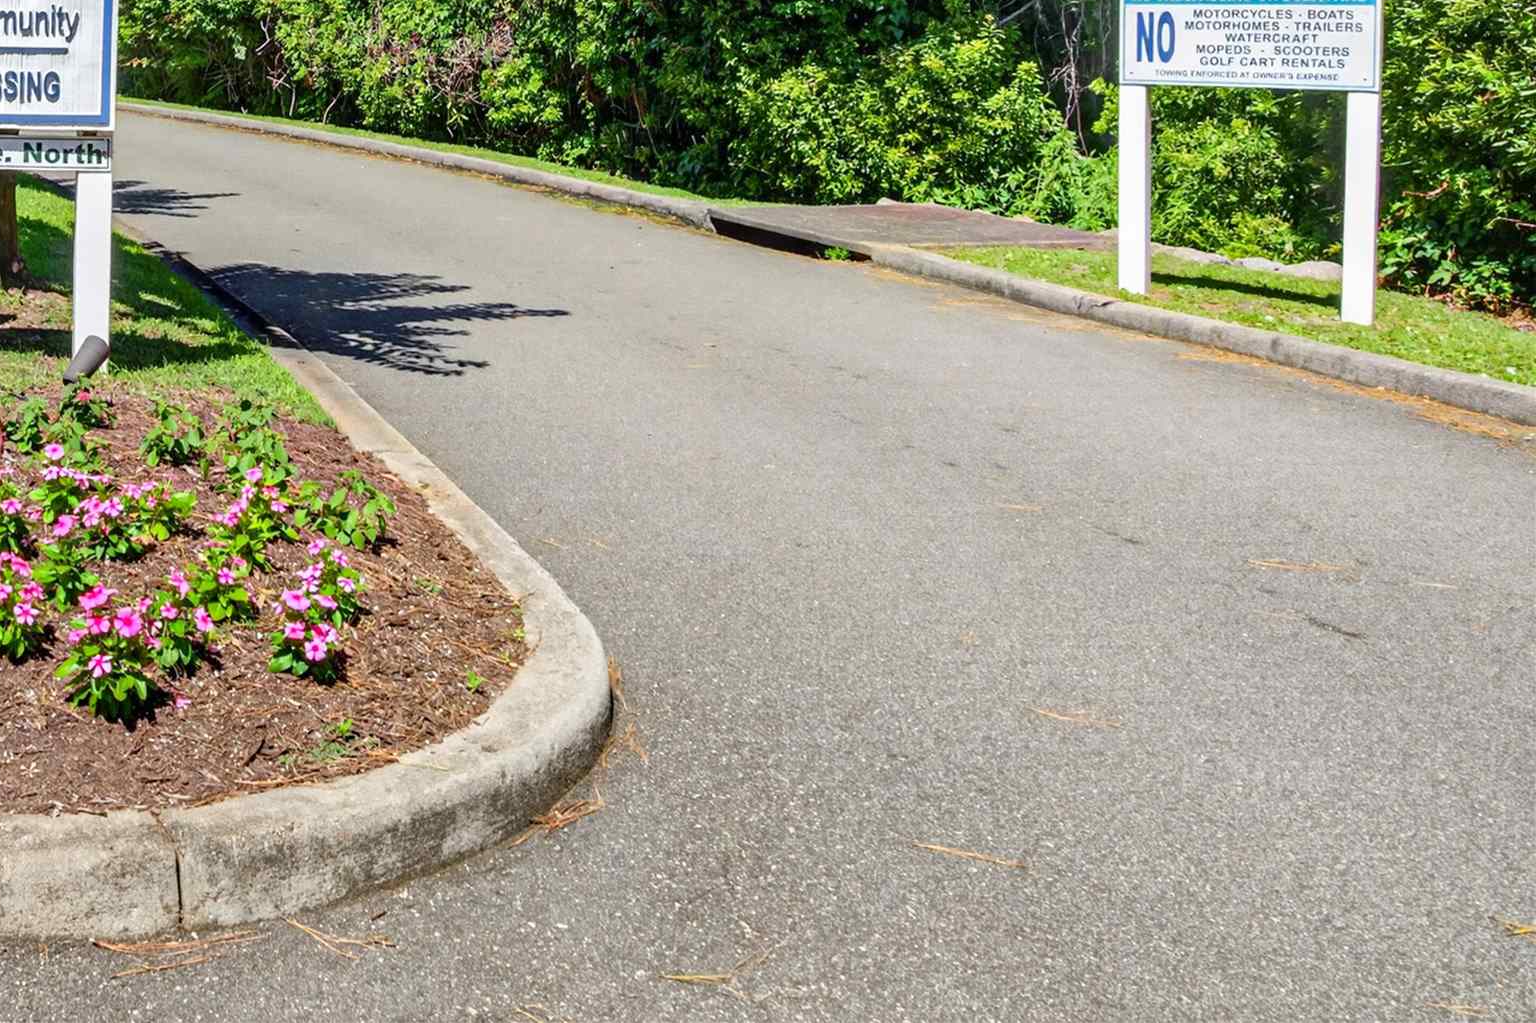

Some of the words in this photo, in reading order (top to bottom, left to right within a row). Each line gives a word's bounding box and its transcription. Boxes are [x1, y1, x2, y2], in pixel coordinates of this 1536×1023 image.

[1192, 9, 1293, 19] MOTORCYCLES
[1307, 9, 1354, 20] BOATS
[1184, 21, 1280, 31] MOTORHOMES
[1294, 22, 1363, 32] TRAILERS
[1136, 11, 1175, 63] NO
[1224, 33, 1319, 43] WATERCRAFT
[1196, 45, 1252, 55] MOPEDS
[1274, 45, 1350, 57] SCOOTERS
[1199, 56, 1234, 66] GOLF
[1239, 57, 1276, 67] CART
[1281, 58, 1345, 69] RENTALS
[23, 142, 103, 165] North
